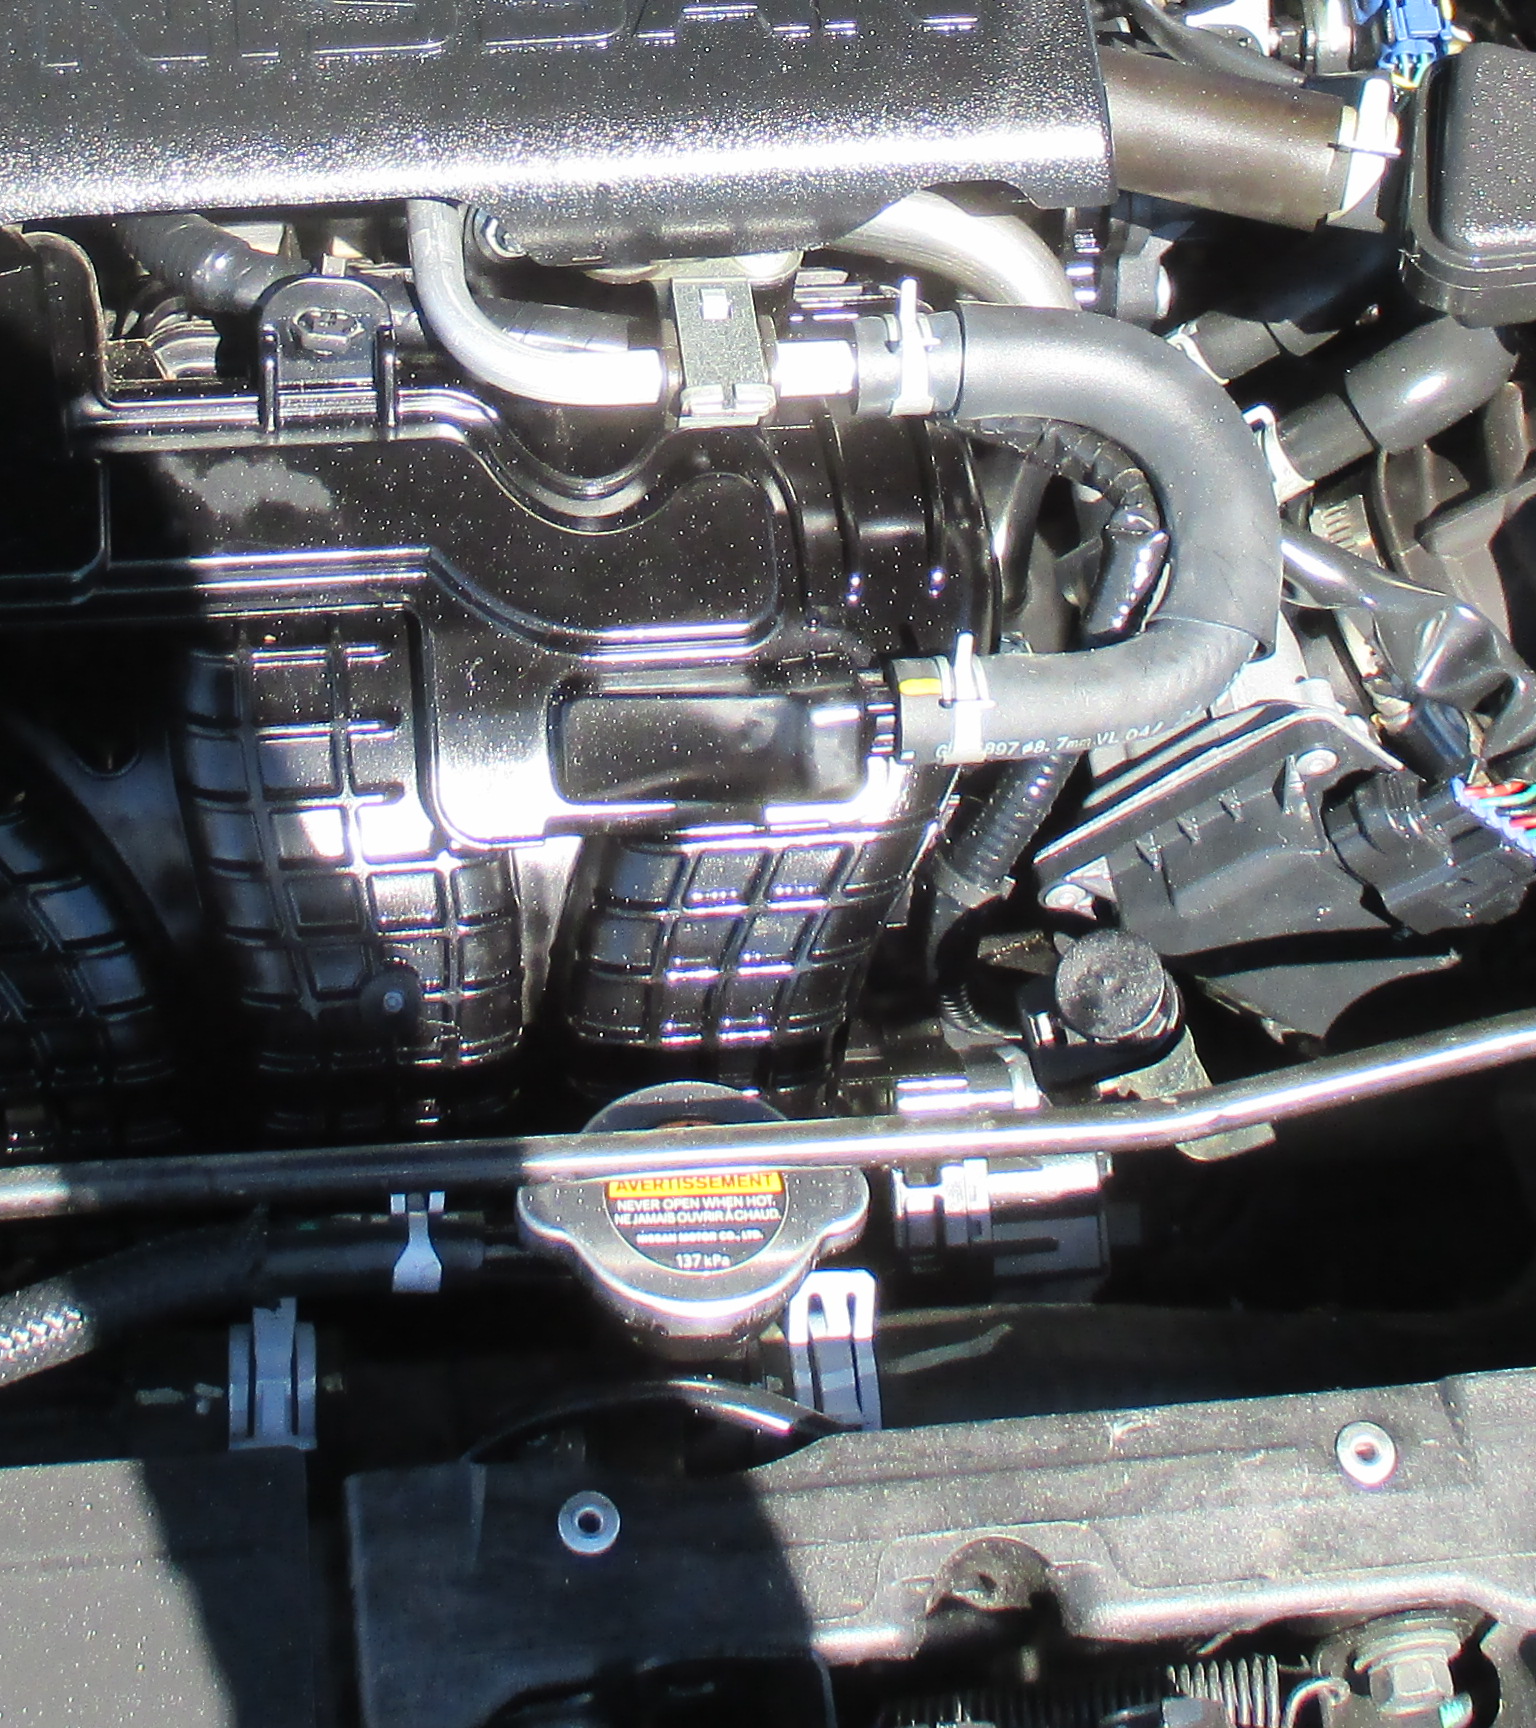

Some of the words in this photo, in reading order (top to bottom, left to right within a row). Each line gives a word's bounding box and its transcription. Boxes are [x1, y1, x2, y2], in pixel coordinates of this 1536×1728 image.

[616, 1174, 773, 1192] AVERTISSEMENT
[617, 1198, 661, 1212] NEVER
[663, 1197, 700, 1212] OPEN
[702, 1195, 744, 1210] WHEN
[614, 1212, 632, 1226] NE
[633, 1211, 676, 1225] JAMAIS
[677, 1210, 724, 1224] OUVRIR
[734, 1207, 782, 1222] CHAUD.
[675, 1252, 703, 1270] 137
[704, 1252, 732, 1269] kPa
